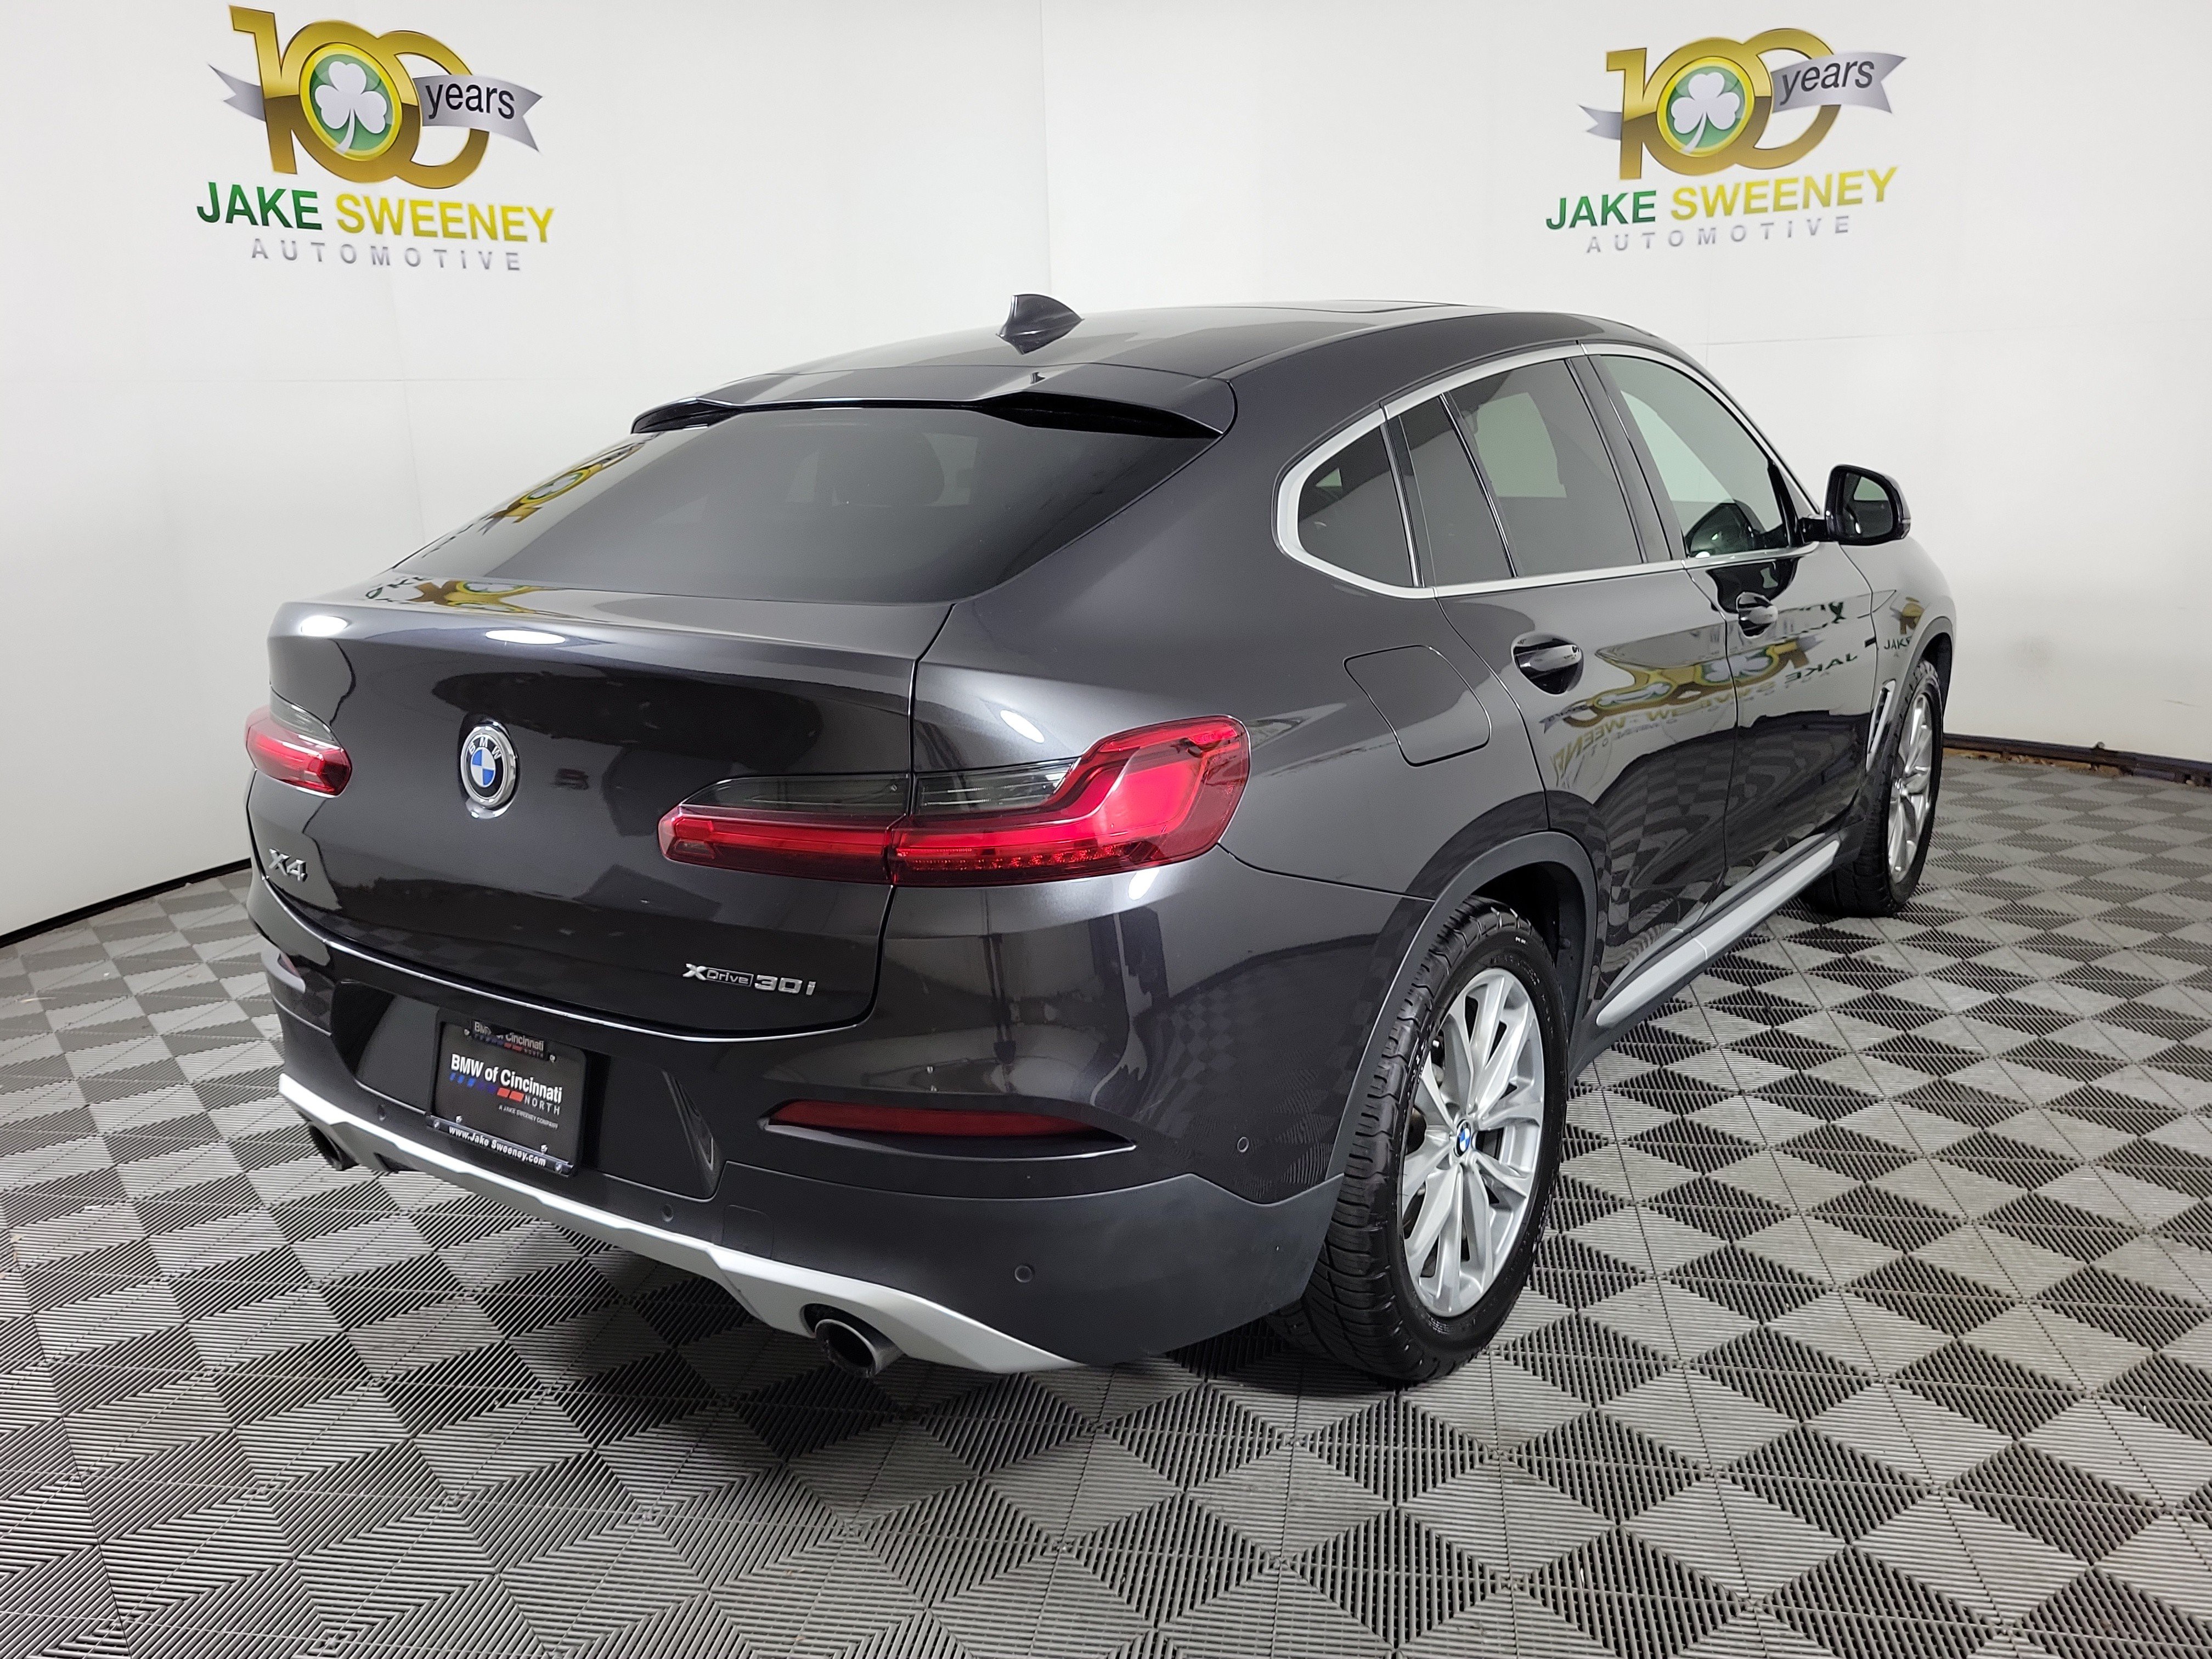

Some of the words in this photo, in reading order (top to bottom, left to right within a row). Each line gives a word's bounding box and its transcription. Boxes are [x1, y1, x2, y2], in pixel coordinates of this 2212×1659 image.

[1780, 60, 1875, 105] years
[426, 83, 515, 120] years
[196, 182, 323, 230] JAKE
[336, 194, 554, 242] SWEENEY
[1546, 190, 1657, 229] JAKE
[1671, 167, 1897, 221] SWEENEY
[1587, 216, 1849, 253] AUTOMOTIVE
[251, 238, 520, 270] AUTOMOTIVE
[469, 736, 501, 760] BMW
[268, 848, 307, 882] X4
[451, 1053, 484, 1077] BMW
[484, 1067, 499, 1082] of
[500, 1069, 562, 1104] Cincinnati
[524, 1096, 560, 1115] NORTH
[491, 1139, 546, 1167] Sweeney.com
